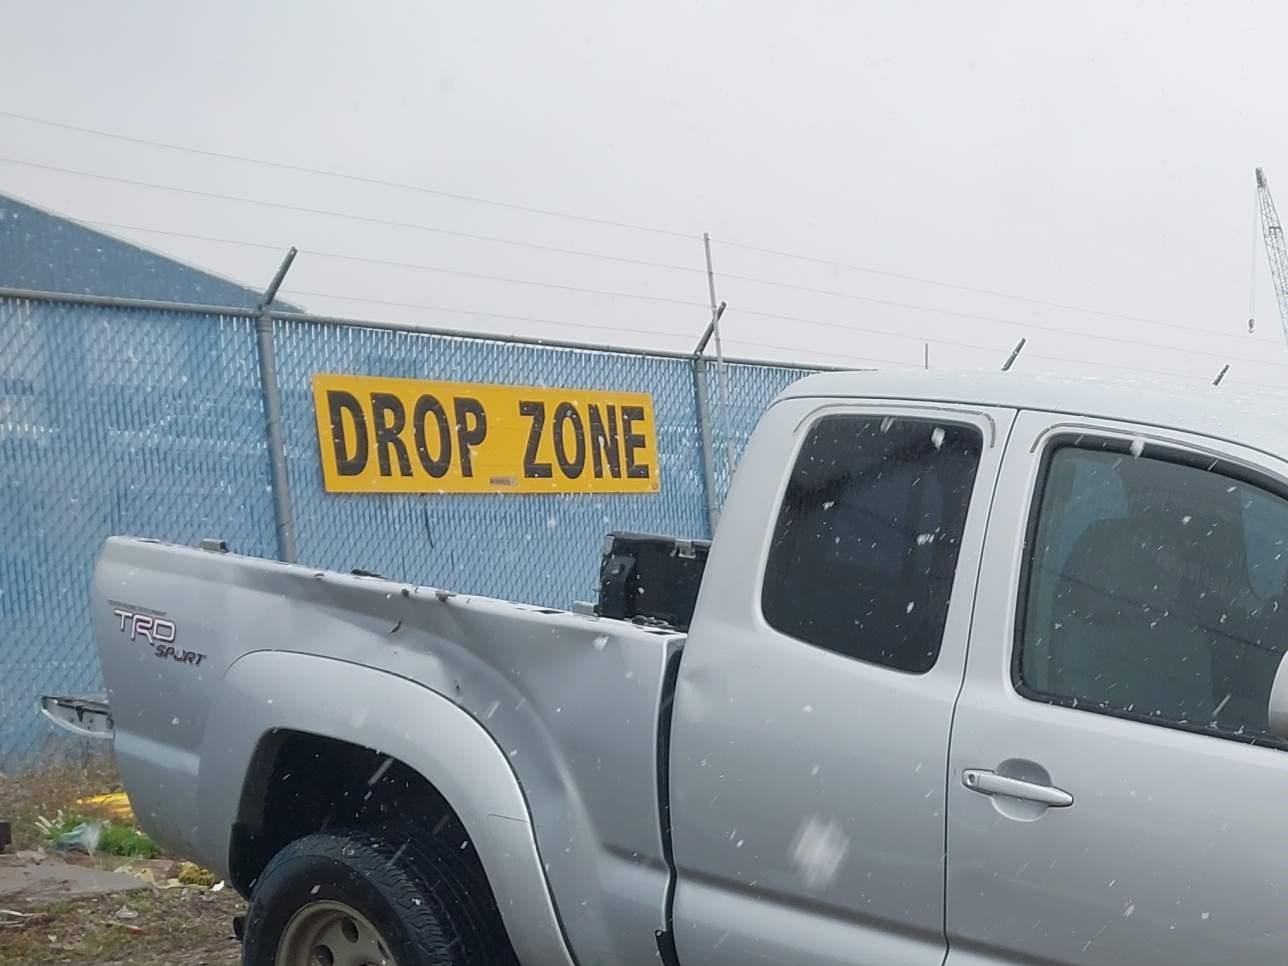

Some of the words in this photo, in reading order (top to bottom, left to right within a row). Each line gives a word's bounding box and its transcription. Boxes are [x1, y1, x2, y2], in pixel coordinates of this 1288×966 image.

[326, 389, 488, 478] DROP
[519, 400, 650, 479] ZONE
[113, 608, 177, 646] TRD
